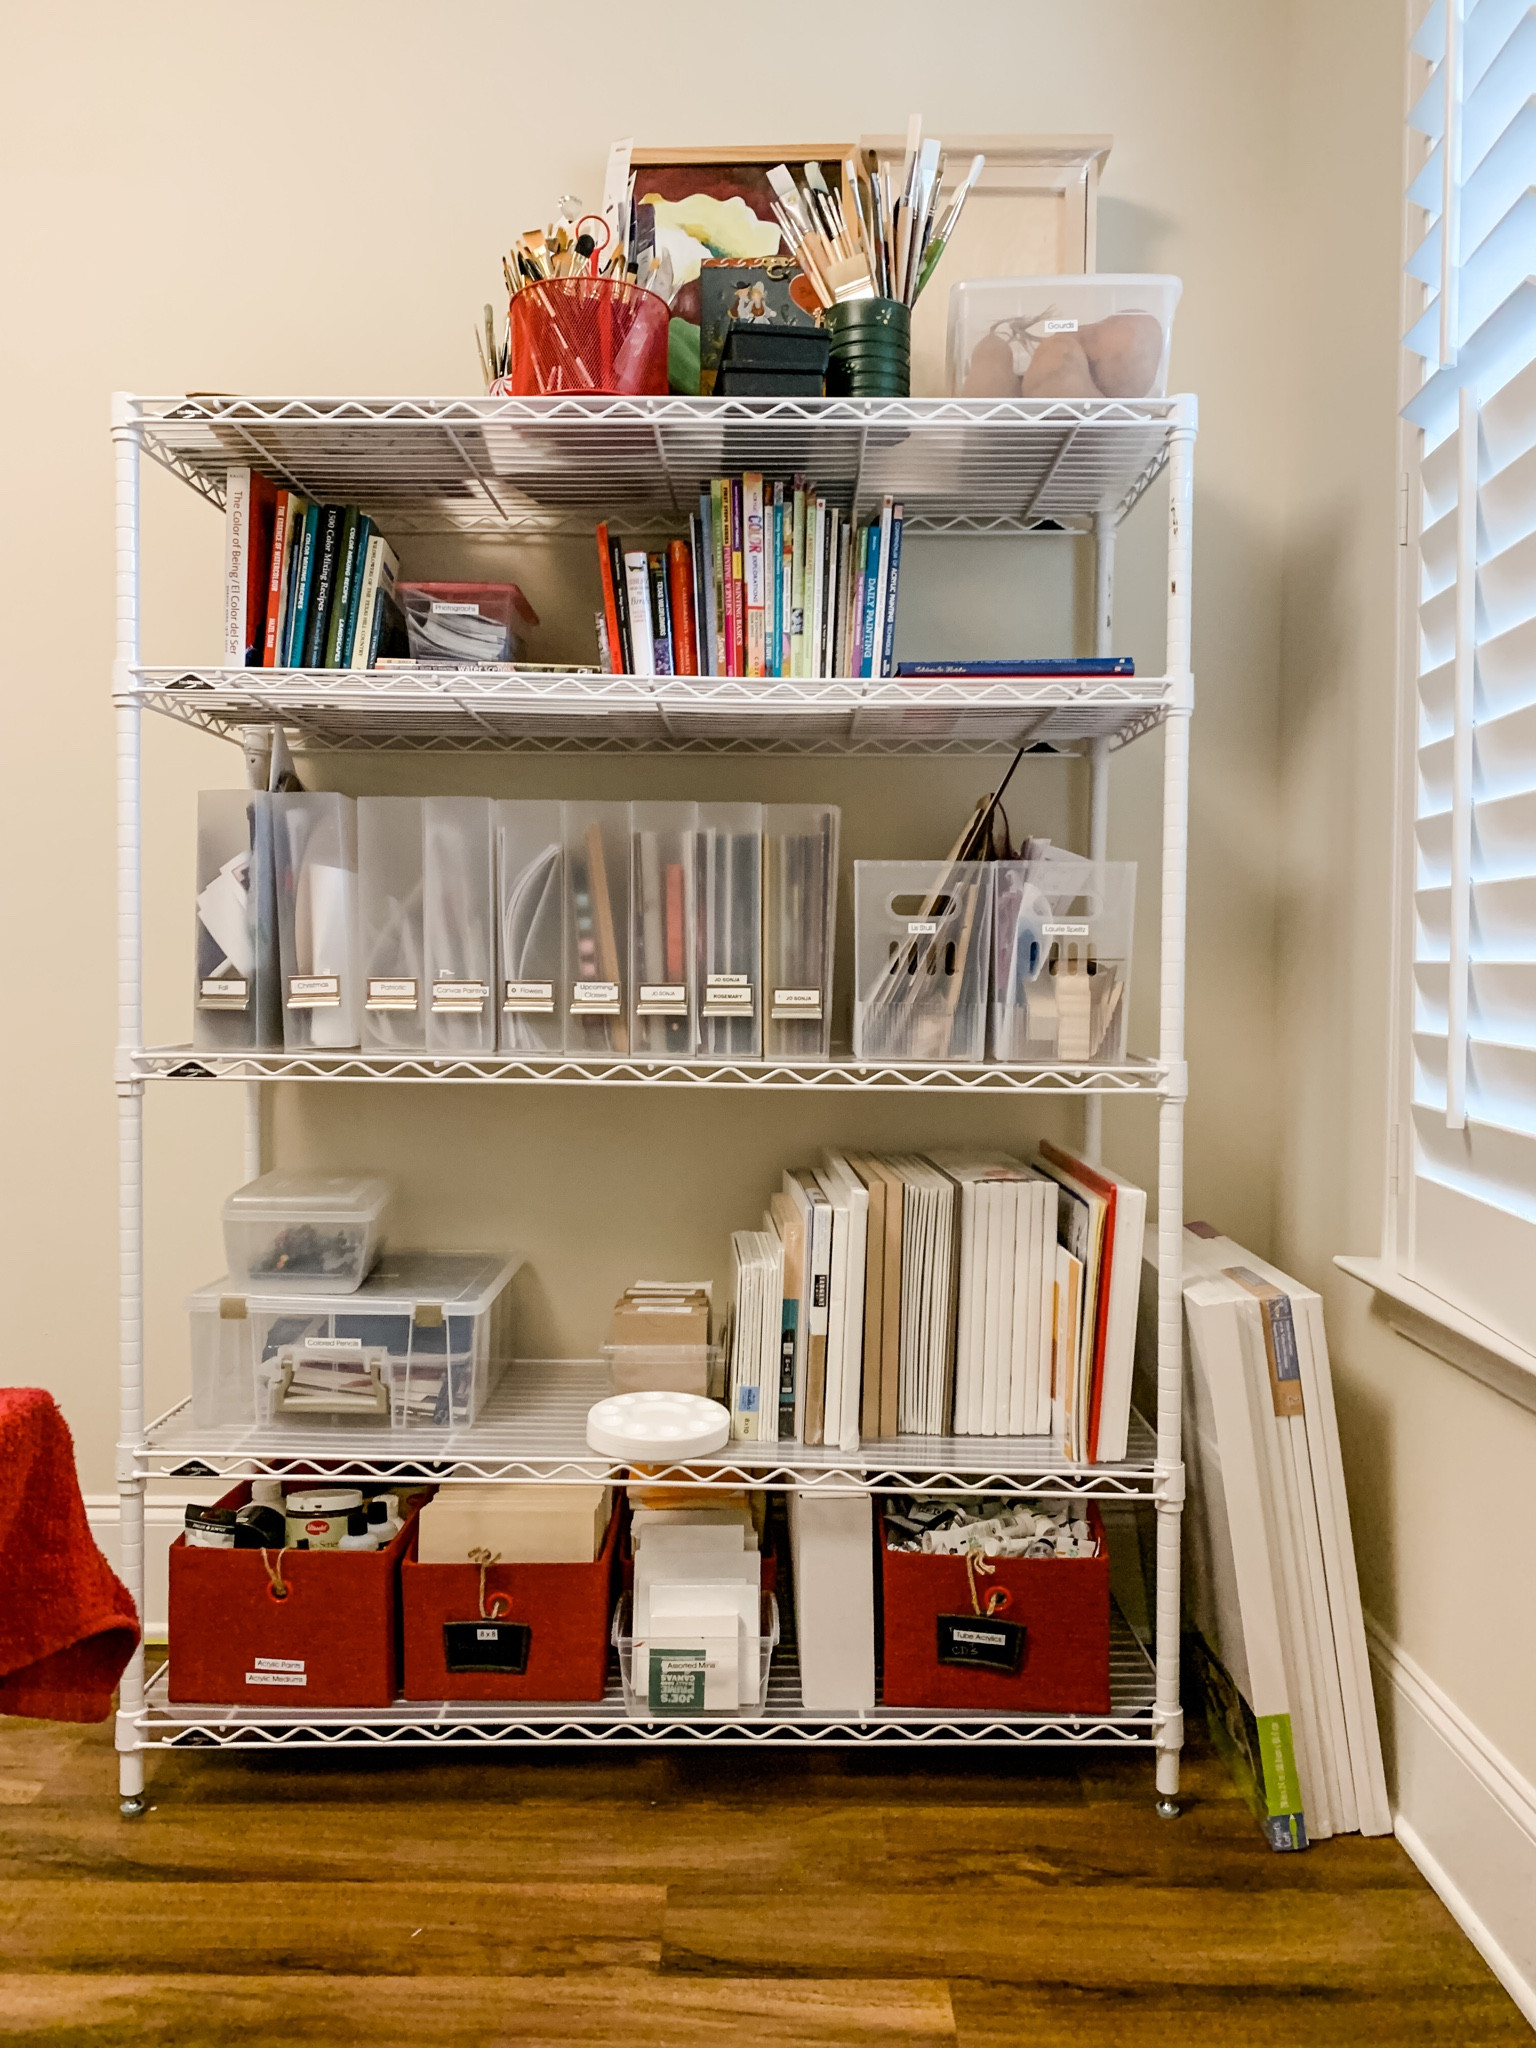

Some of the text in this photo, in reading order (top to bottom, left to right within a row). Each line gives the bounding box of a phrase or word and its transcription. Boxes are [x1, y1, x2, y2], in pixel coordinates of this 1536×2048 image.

[1048, 321, 1074, 330] Gourds
[233, 491, 243, 509] The
[232, 511, 242, 536] Color
[327, 510, 337, 528] 1500
[325, 530, 335, 552] Color
[348, 527, 357, 549] COLOR
[748, 515, 762, 553] COLOR
[232, 539, 242, 548] of
[229, 550, 241, 578] Being
[297, 533, 312, 609] COLOR MIXING RECIPES
[320, 553, 332, 581] Mixing
[345, 550, 354, 577] MIXING
[723, 547, 731, 580] PAINTING
[367, 578, 374, 586] OF
[752, 555, 760, 603] EXPLORATIONS
[889, 568, 898, 593] ACRYLIC
[230, 585, 240, 594] El
[317, 582, 329, 611] Recipes
[341, 577, 351, 604] RECIPES
[656, 581, 664, 598] TEXAS
[230, 596, 240, 620] Color
[435, 604, 476, 613] Photographs
[735, 581, 743, 618] PAINTING
[887, 594, 896, 623] PAINTING
[864, 577, 876, 658] DAILY PAINTING
[230, 622, 239, 637] del
[229, 640, 239, 655] Ser
[334, 619, 345, 663] LANDSCAPES
[358, 630, 369, 656] COUNTRY
[297, 982, 329, 990] Christmas
[463, 987, 488, 996] Painting
[580, 983, 613, 991] Upcoming
[307, 1339, 335, 1347] Colored
[956, 1631, 1002, 1643] Tube Acrylics
[257, 1660, 279, 1668] Acrylic
[248, 1674, 303, 1683] Acrylic Mediums
[660, 1674, 696, 1682] CANVAS
[660, 1685, 695, 1694] PRIME
[660, 1694, 695, 1704] JOE'S
